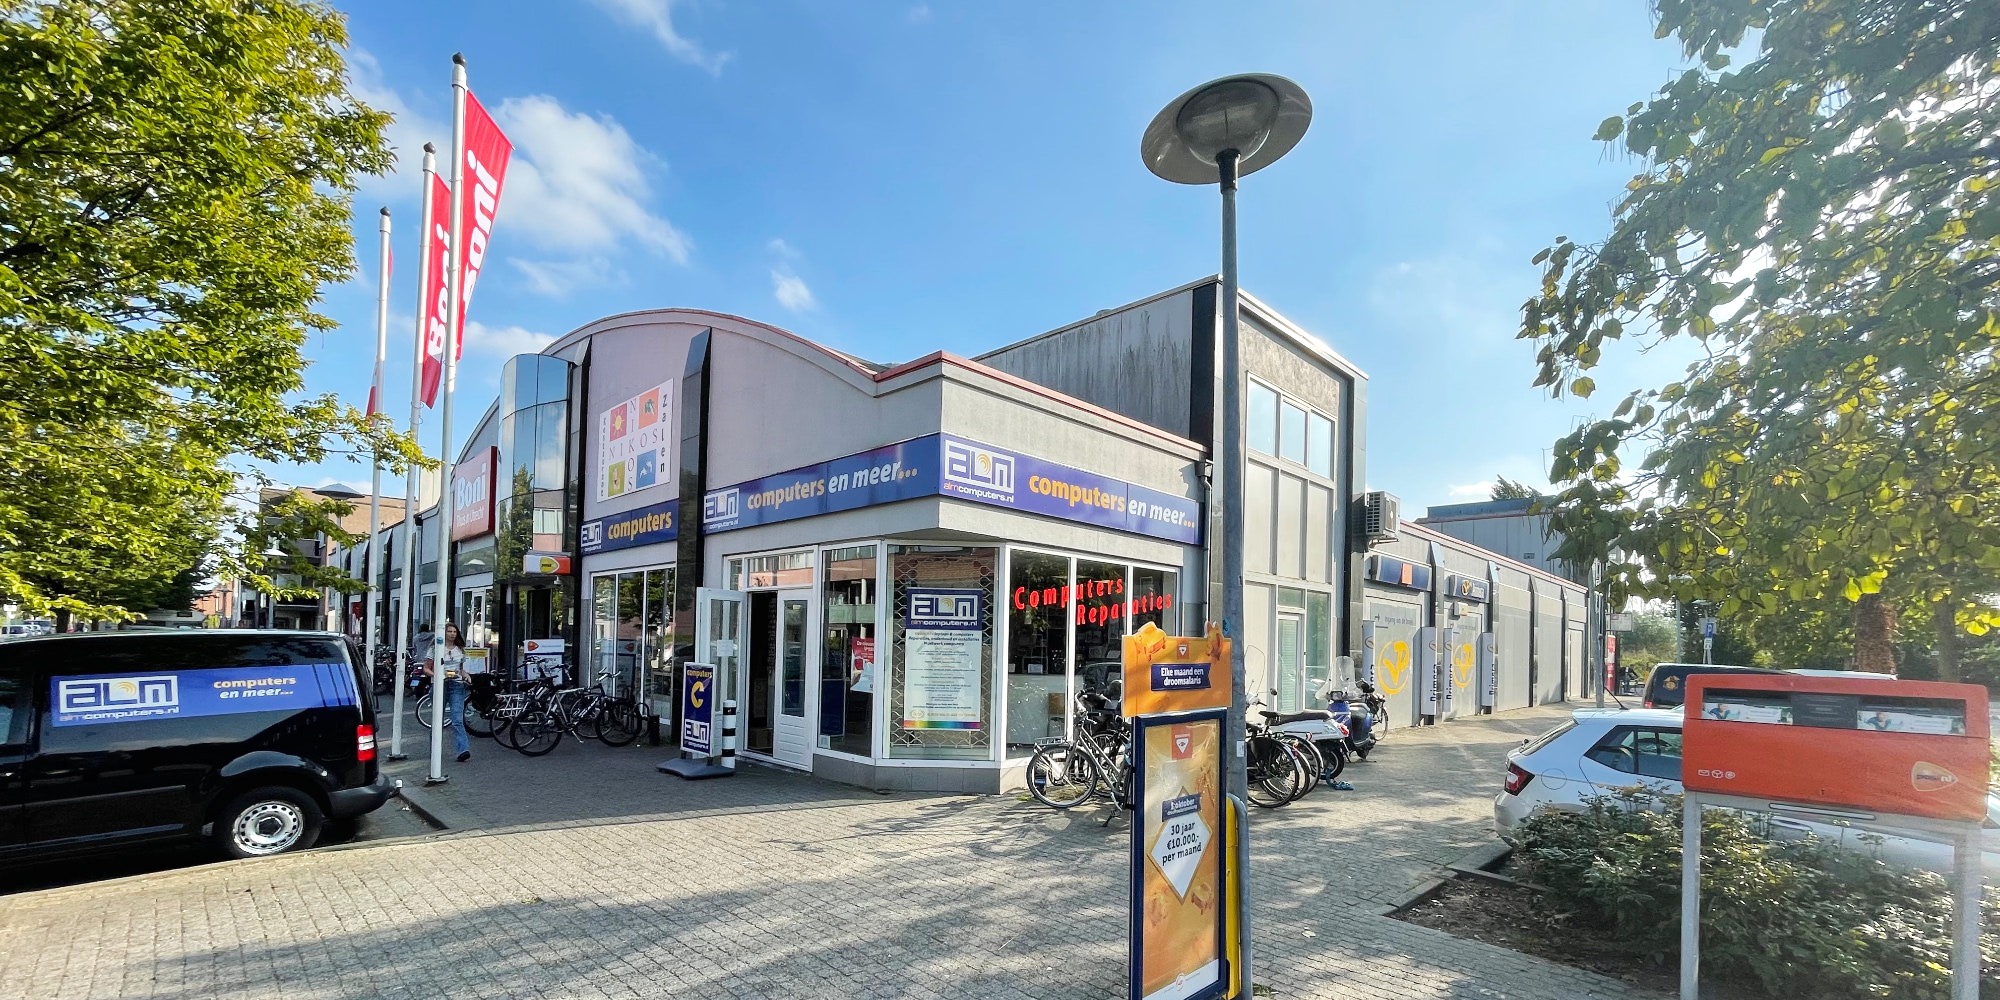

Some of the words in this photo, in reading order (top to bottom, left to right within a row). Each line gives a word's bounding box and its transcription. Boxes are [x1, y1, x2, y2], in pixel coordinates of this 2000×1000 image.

[457, 463, 486, 511] Boni
[747, 477, 825, 510] computers
[828, 473, 848, 494] en
[852, 460, 918, 489] meer...
[943, 482, 1015, 504] almcomputers.nl
[1029, 474, 1126, 513] computers
[1128, 497, 1147, 518] en
[1149, 503, 1195, 530] meer...
[608, 511, 672, 541] computers
[1014, 578, 1124, 610] Computers
[686, 669, 712, 679] computers
[1161, 667, 1173, 677] Elke
[1174, 666, 1193, 676] maand
[1194, 667, 1204, 676] een
[213, 676, 297, 690] computers
[1163, 676, 1202, 686] droomsalaris
[220, 689, 240, 699] en
[242, 687, 294, 699] meer...
[59, 706, 180, 722] almcomputers.nl
[1171, 824, 1180, 836] 30
[1181, 822, 1195, 835] jaar
[1166, 833, 1199, 851] €10.000,-
[1162, 852, 1176, 867] per
[1178, 842, 1202, 859] maand
